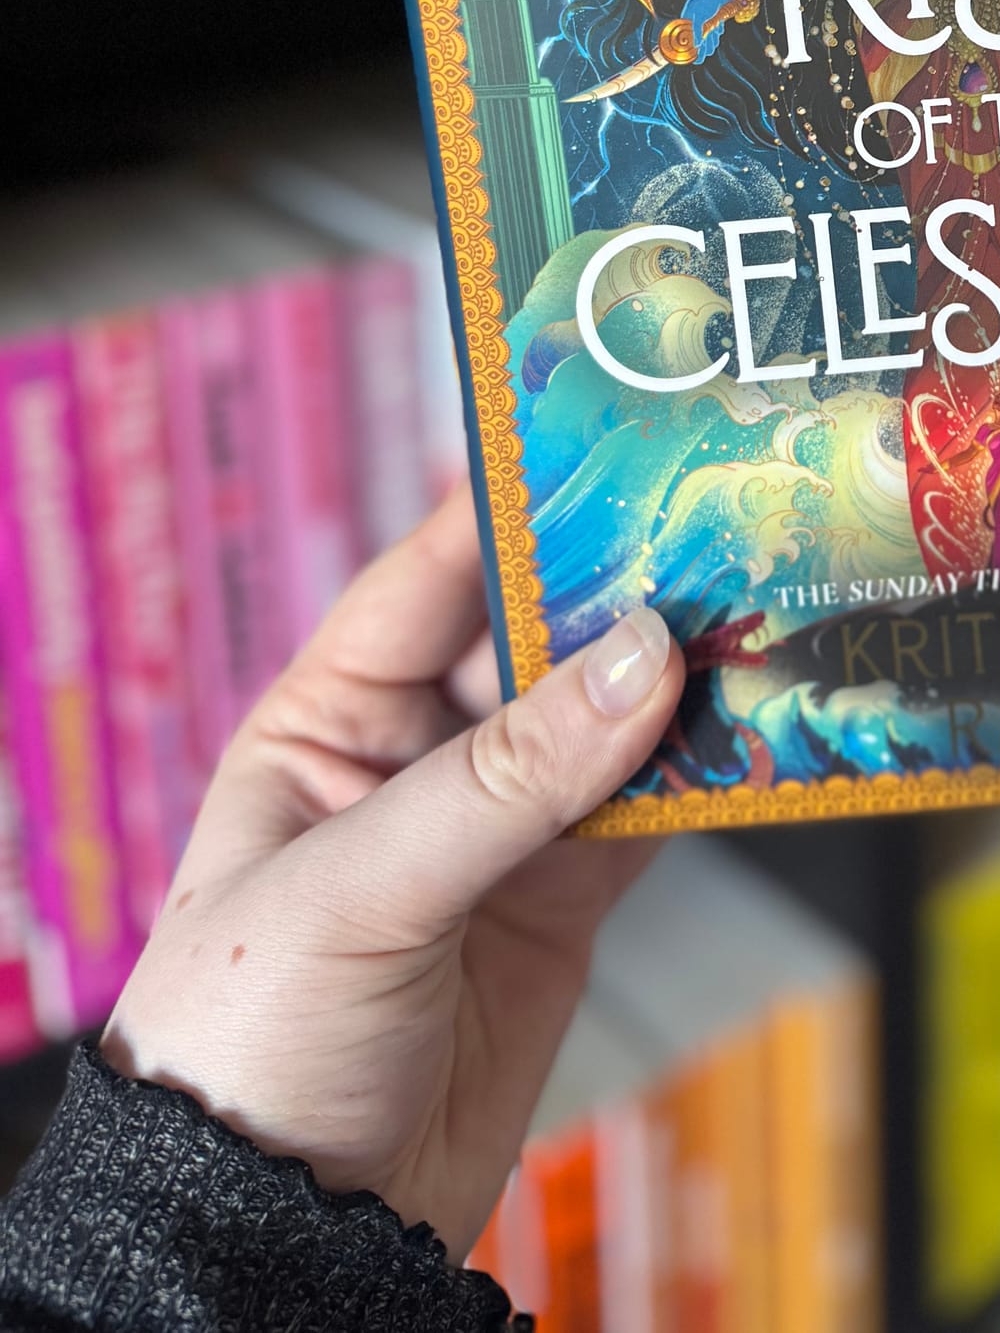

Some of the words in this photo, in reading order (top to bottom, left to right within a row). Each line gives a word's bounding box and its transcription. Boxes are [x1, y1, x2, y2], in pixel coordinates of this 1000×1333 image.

[853, 100, 953, 170] OF
[773, 582, 840, 609] THE
[848, 571, 961, 604] SUNDAY
